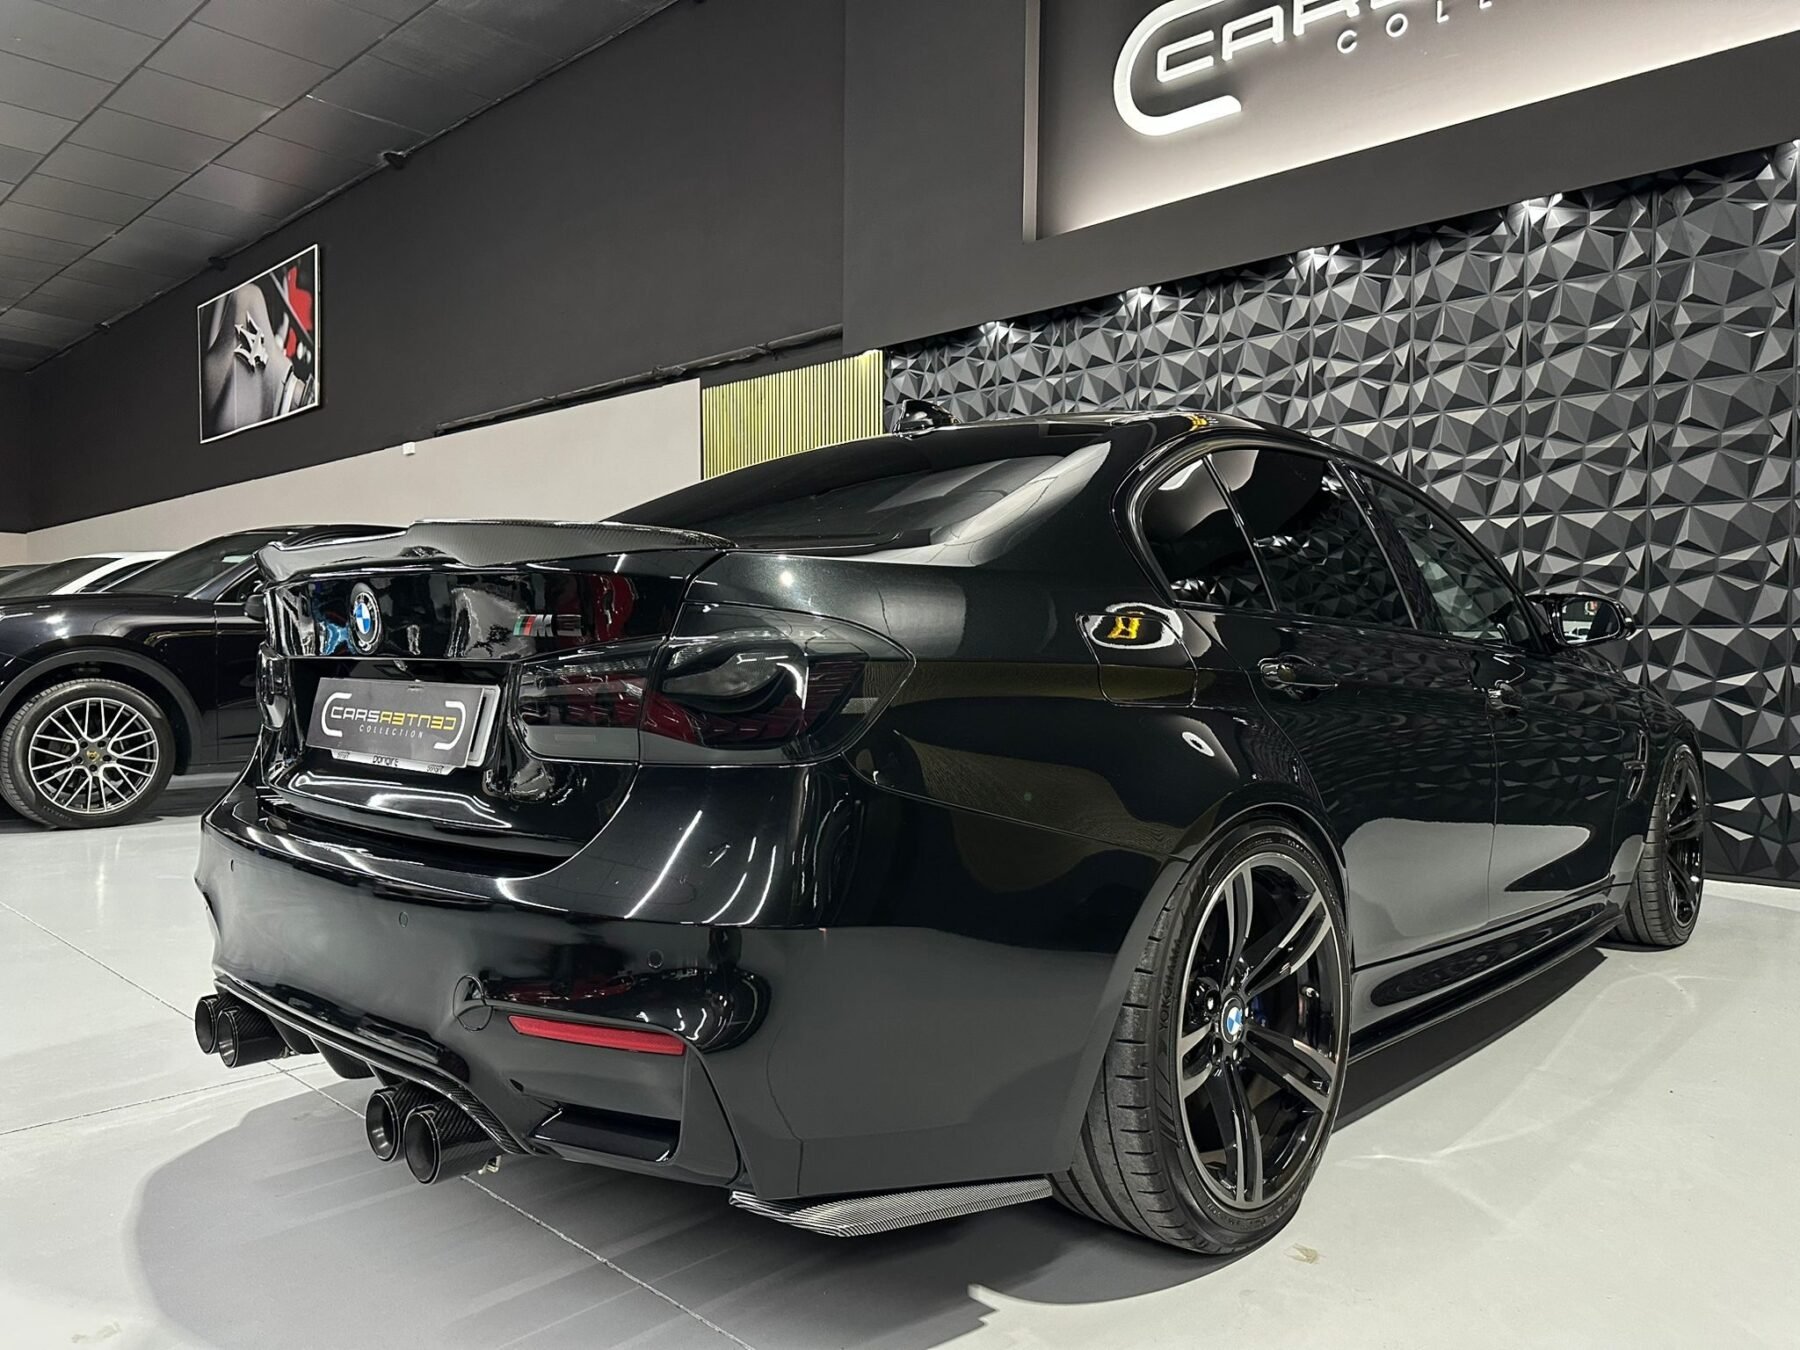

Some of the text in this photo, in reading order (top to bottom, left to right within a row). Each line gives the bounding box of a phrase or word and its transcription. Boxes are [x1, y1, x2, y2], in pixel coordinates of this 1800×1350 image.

[1156, 0, 1401, 83] CAR
[359, 724, 424, 739] COLLECTION
[1159, 939, 1183, 1031] YOKOHAMA
